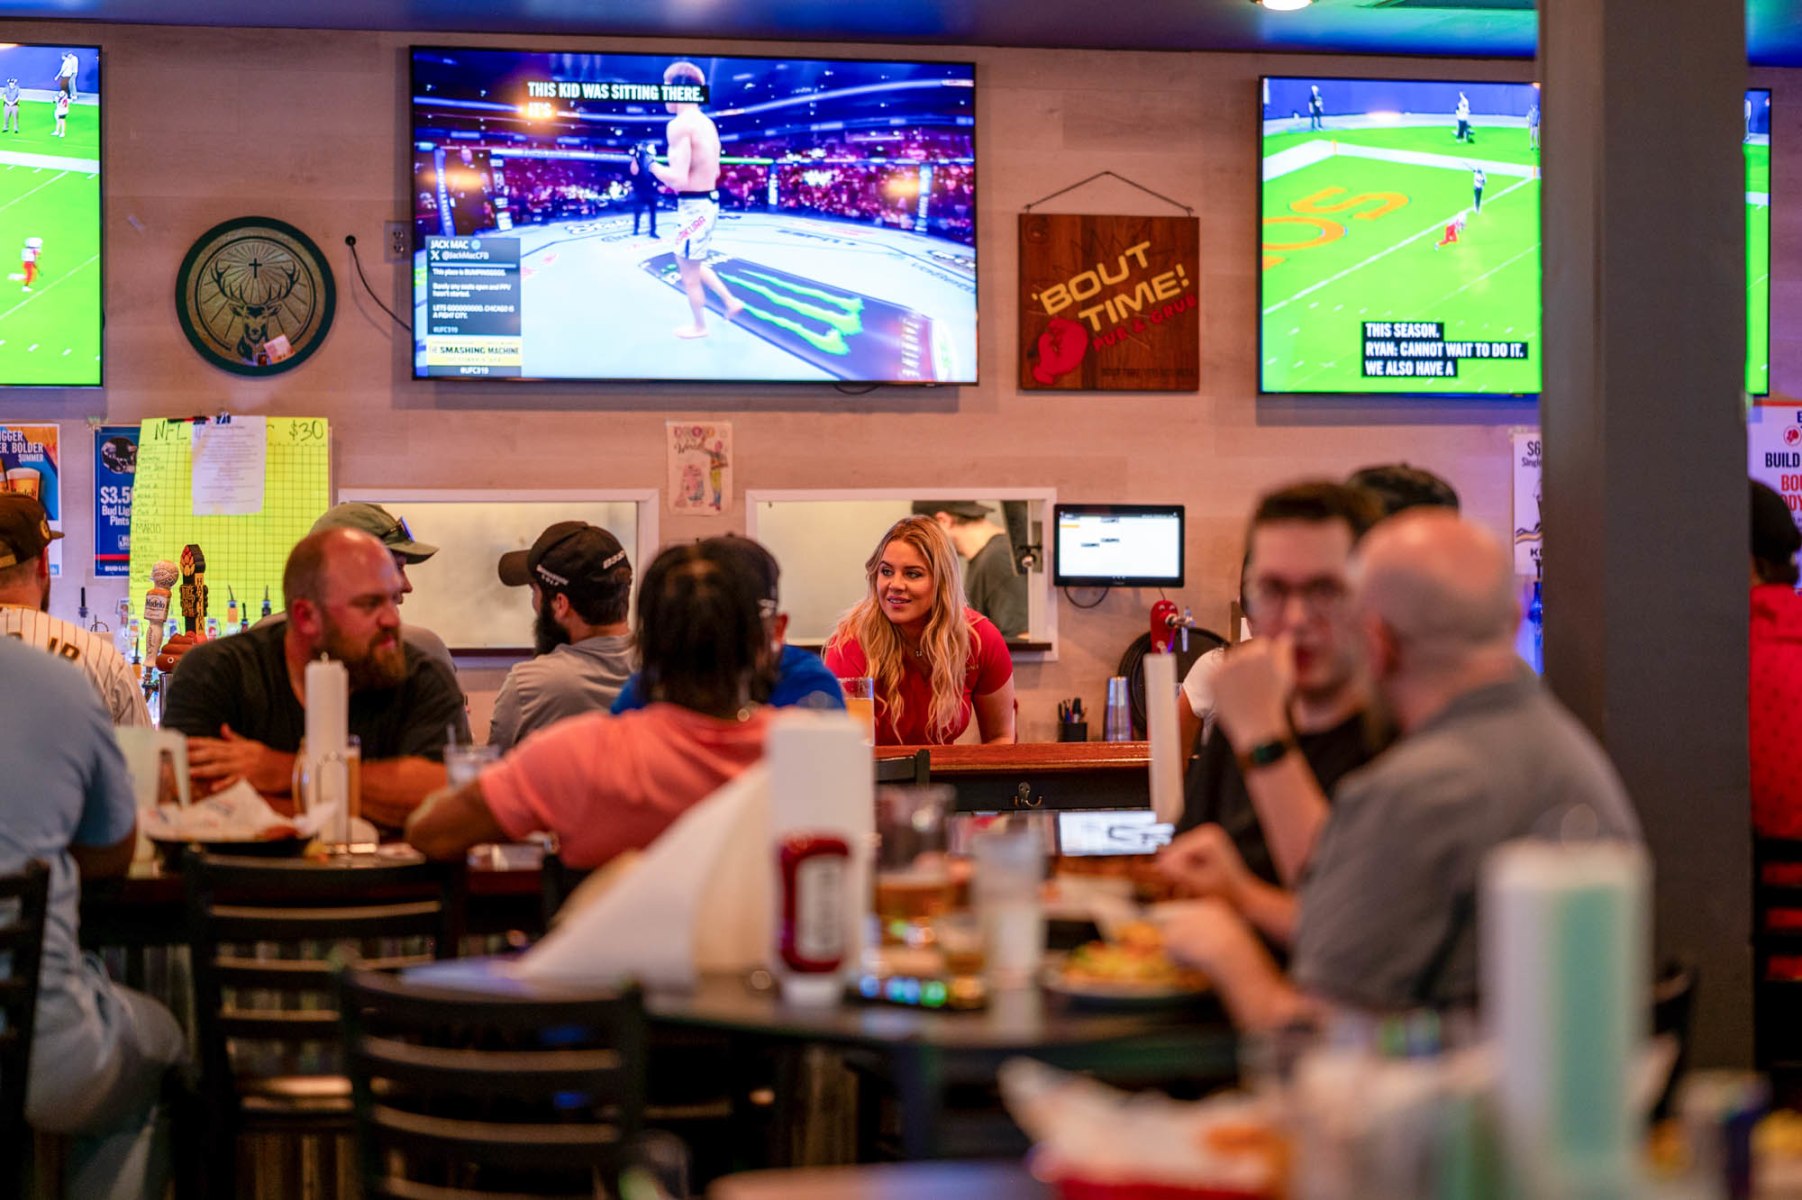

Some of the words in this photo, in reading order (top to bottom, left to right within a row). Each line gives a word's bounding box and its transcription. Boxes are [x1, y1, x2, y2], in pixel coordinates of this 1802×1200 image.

[528, 82, 556, 97] THIS
[559, 83, 580, 98] KID
[582, 83, 609, 99] WAS
[611, 84, 659, 100] SITTING
[662, 86, 704, 102] THERE.
[431, 240, 449, 249] JACK
[450, 240, 469, 250] MAC
[1078, 263, 1190, 332] TIME!
[1092, 326, 1128, 352] PUB
[1131, 319, 1146, 333] &
[1151, 293, 1197, 325] GRUB
[1365, 323, 1392, 338] THIS
[1393, 323, 1440, 338] SEASON.
[440, 346, 486, 354] SMASHING
[488, 347, 519, 355] MACHINE
[1365, 341, 1398, 357] RYAN:
[1400, 342, 1444, 357] CANNOT
[1445, 342, 1473, 358] WAIT
[1475, 343, 1489, 358] TO
[1491, 343, 1508, 358] DO
[1509, 343, 1524, 358] IT.
[1365, 361, 1384, 376] WE
[1386, 361, 1414, 376] ALSO
[1415, 361, 1443, 376] HAVE
[1445, 361, 1455, 376] A
[154, 420, 187, 441] NFL
[289, 419, 324, 442] $30
[12, 442, 44, 453] BOLDER
[1765, 453, 1800, 468] BUILD
[100, 486, 133, 504] $3.5
[102, 505, 117, 516] Bud
[118, 505, 132, 518] Lig
[110, 516, 130, 525] Pints
